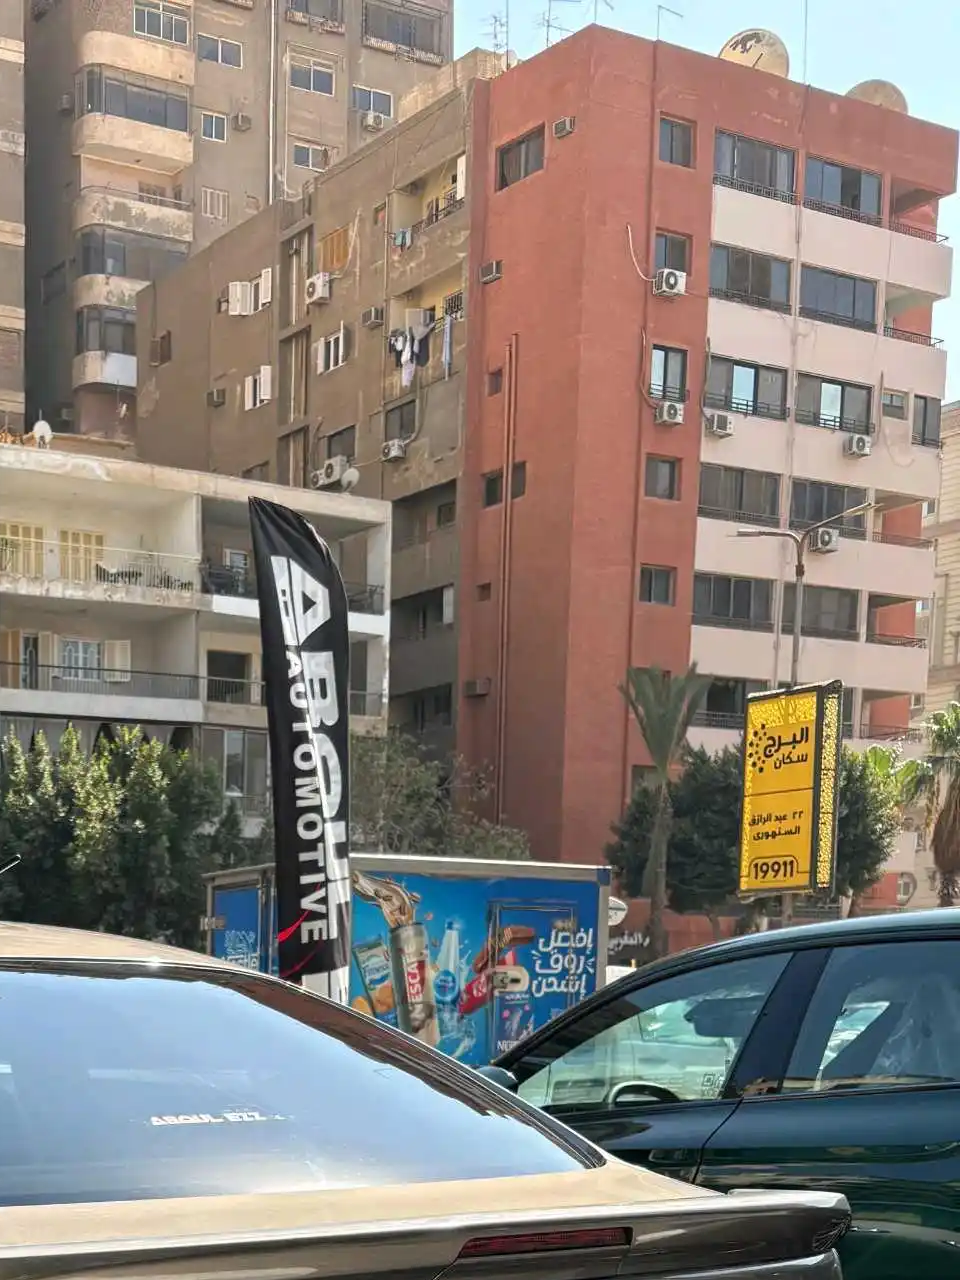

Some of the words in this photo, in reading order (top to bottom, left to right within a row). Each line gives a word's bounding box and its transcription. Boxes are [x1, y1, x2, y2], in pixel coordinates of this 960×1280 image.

[763, 727, 809, 758] البرج
[774, 752, 808, 769] سكان
[286, 651, 328, 944] AUTOMOTIVE
[774, 814, 788, 824] عبد
[753, 860, 795, 880] 19911
